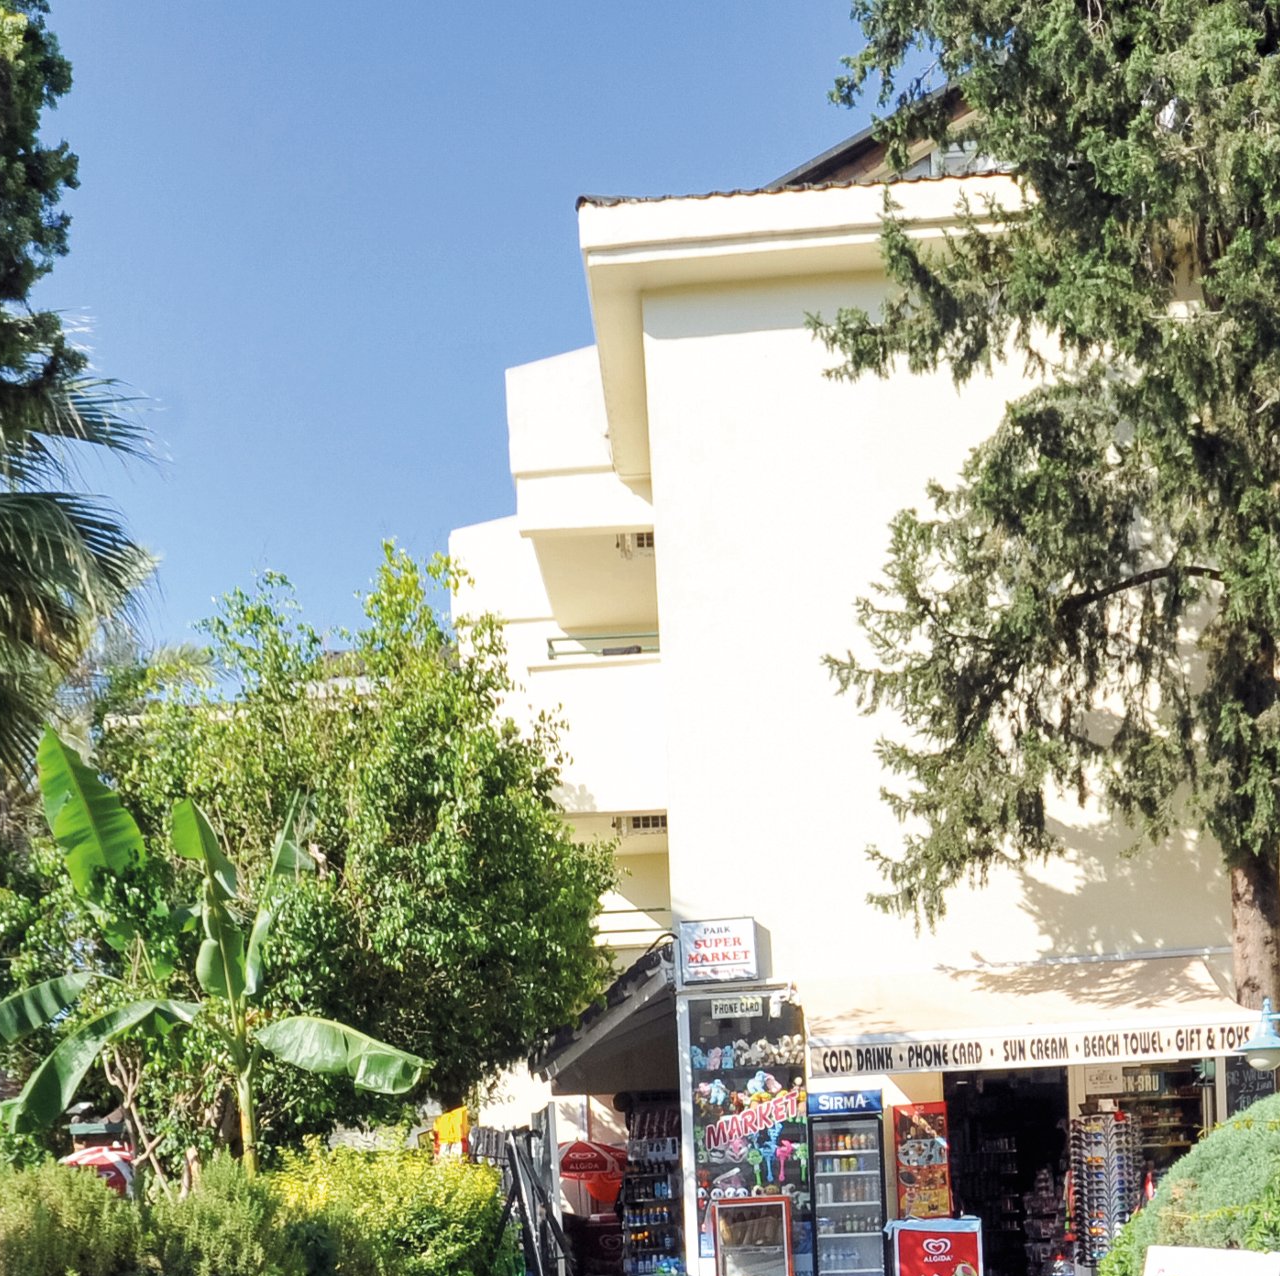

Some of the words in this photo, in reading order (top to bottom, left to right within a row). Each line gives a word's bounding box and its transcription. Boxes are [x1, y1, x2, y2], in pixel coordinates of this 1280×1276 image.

[703, 926, 730, 935] PARK
[694, 936, 742, 949] SUPER
[688, 950, 750, 964] MARKET
[714, 1002, 738, 1014] PHONE
[740, 1001, 759, 1013] CARD
[822, 1050, 852, 1073] COLD
[856, 1047, 894, 1070] DRINK
[908, 1043, 948, 1068] PHONE
[952, 1041, 983, 1065] CARD
[1003, 1039, 1026, 1062] SUN
[1030, 1037, 1069, 1060] CREAM
[1083, 1034, 1120, 1058] BEACH
[1123, 1031, 1163, 1055] TOWEL
[1176, 1028, 1201, 1051] GIFT
[1206, 1028, 1216, 1050] &
[1220, 1026, 1250, 1050] TOYS
[1122, 1074, 1160, 1092] RN-BRU
[818, 1093, 867, 1111] SIRMA
[705, 1090, 799, 1151] MARKET
[569, 1162, 600, 1170] ALGIDA
[923, 1254, 952, 1263] ALGIDA
